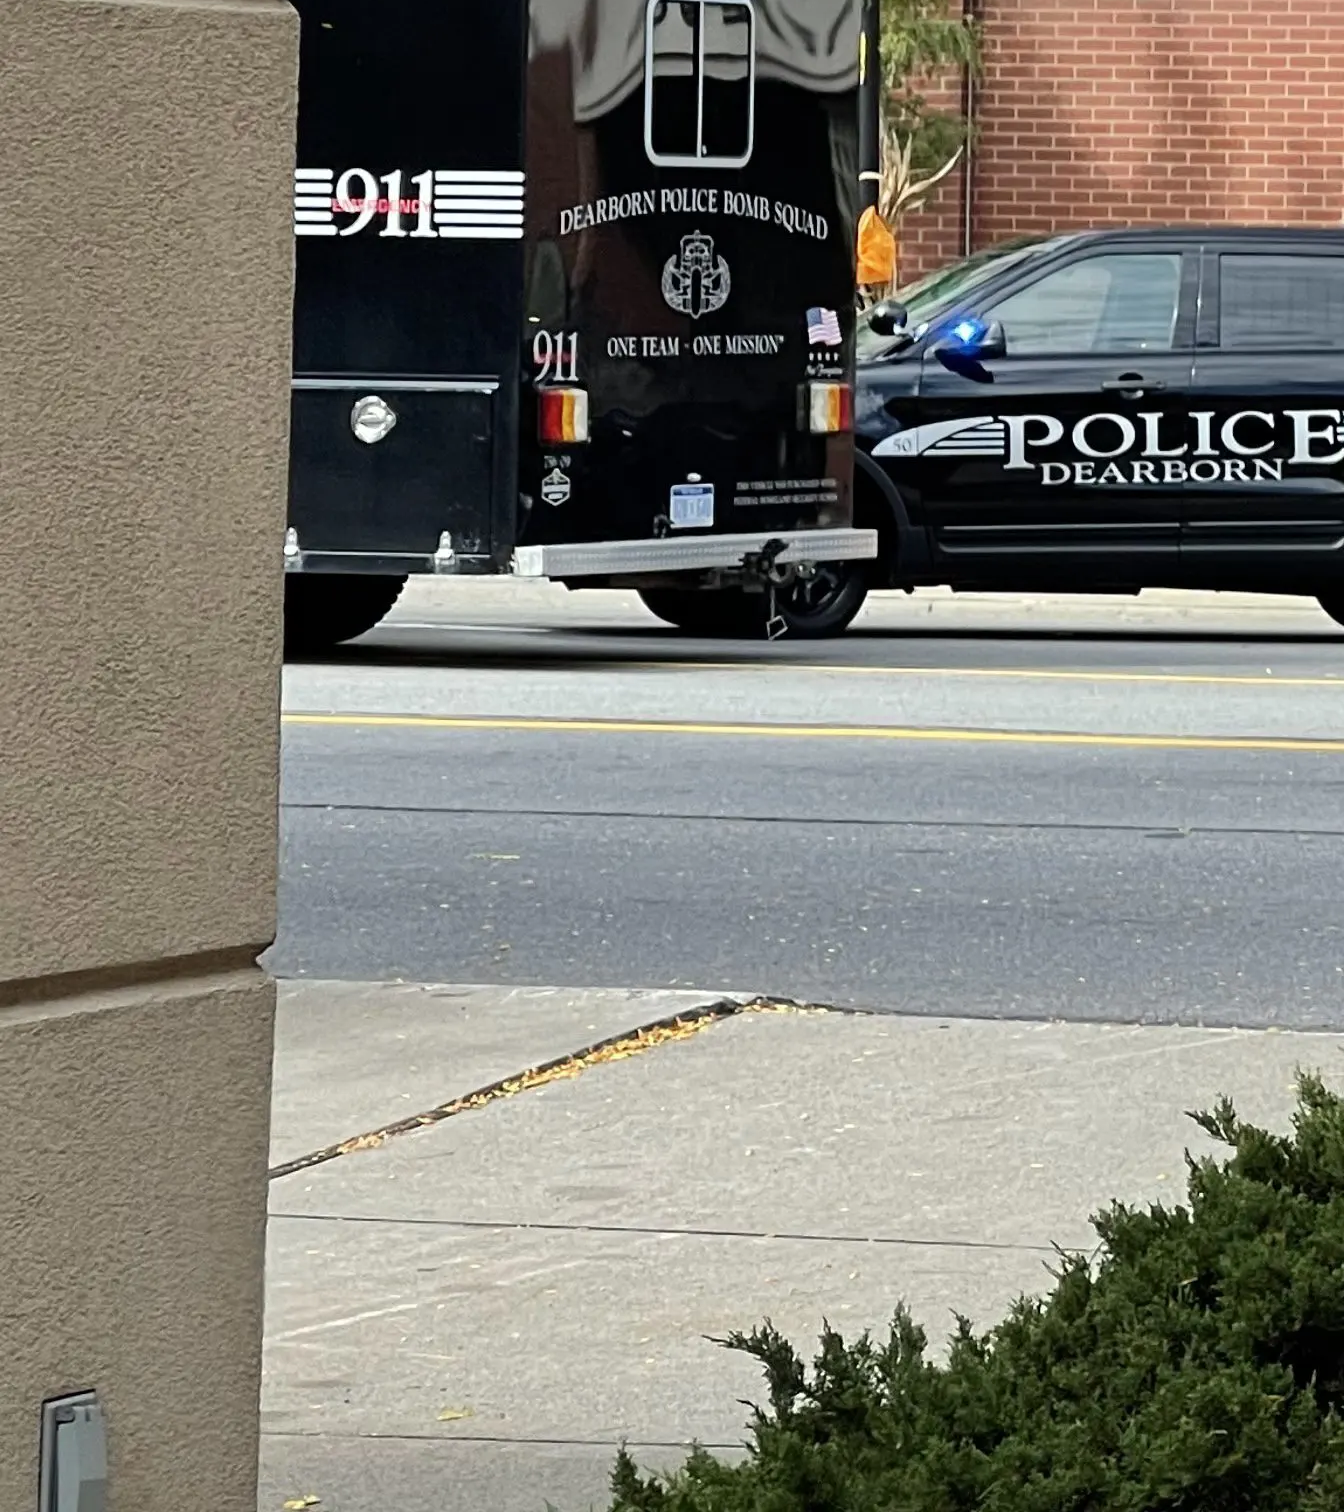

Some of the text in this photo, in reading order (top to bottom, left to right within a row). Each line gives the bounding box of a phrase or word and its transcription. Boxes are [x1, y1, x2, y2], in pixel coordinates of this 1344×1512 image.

[336, 167, 439, 237] 911
[559, 187, 829, 240] DEARBORN POLICE BOMB SQUAD
[532, 330, 579, 382] 911
[607, 337, 637, 357] ONE
[641, 336, 680, 356] TEAM
[692, 335, 721, 355] ONE
[1040, 458, 1284, 485] DEARBORN
